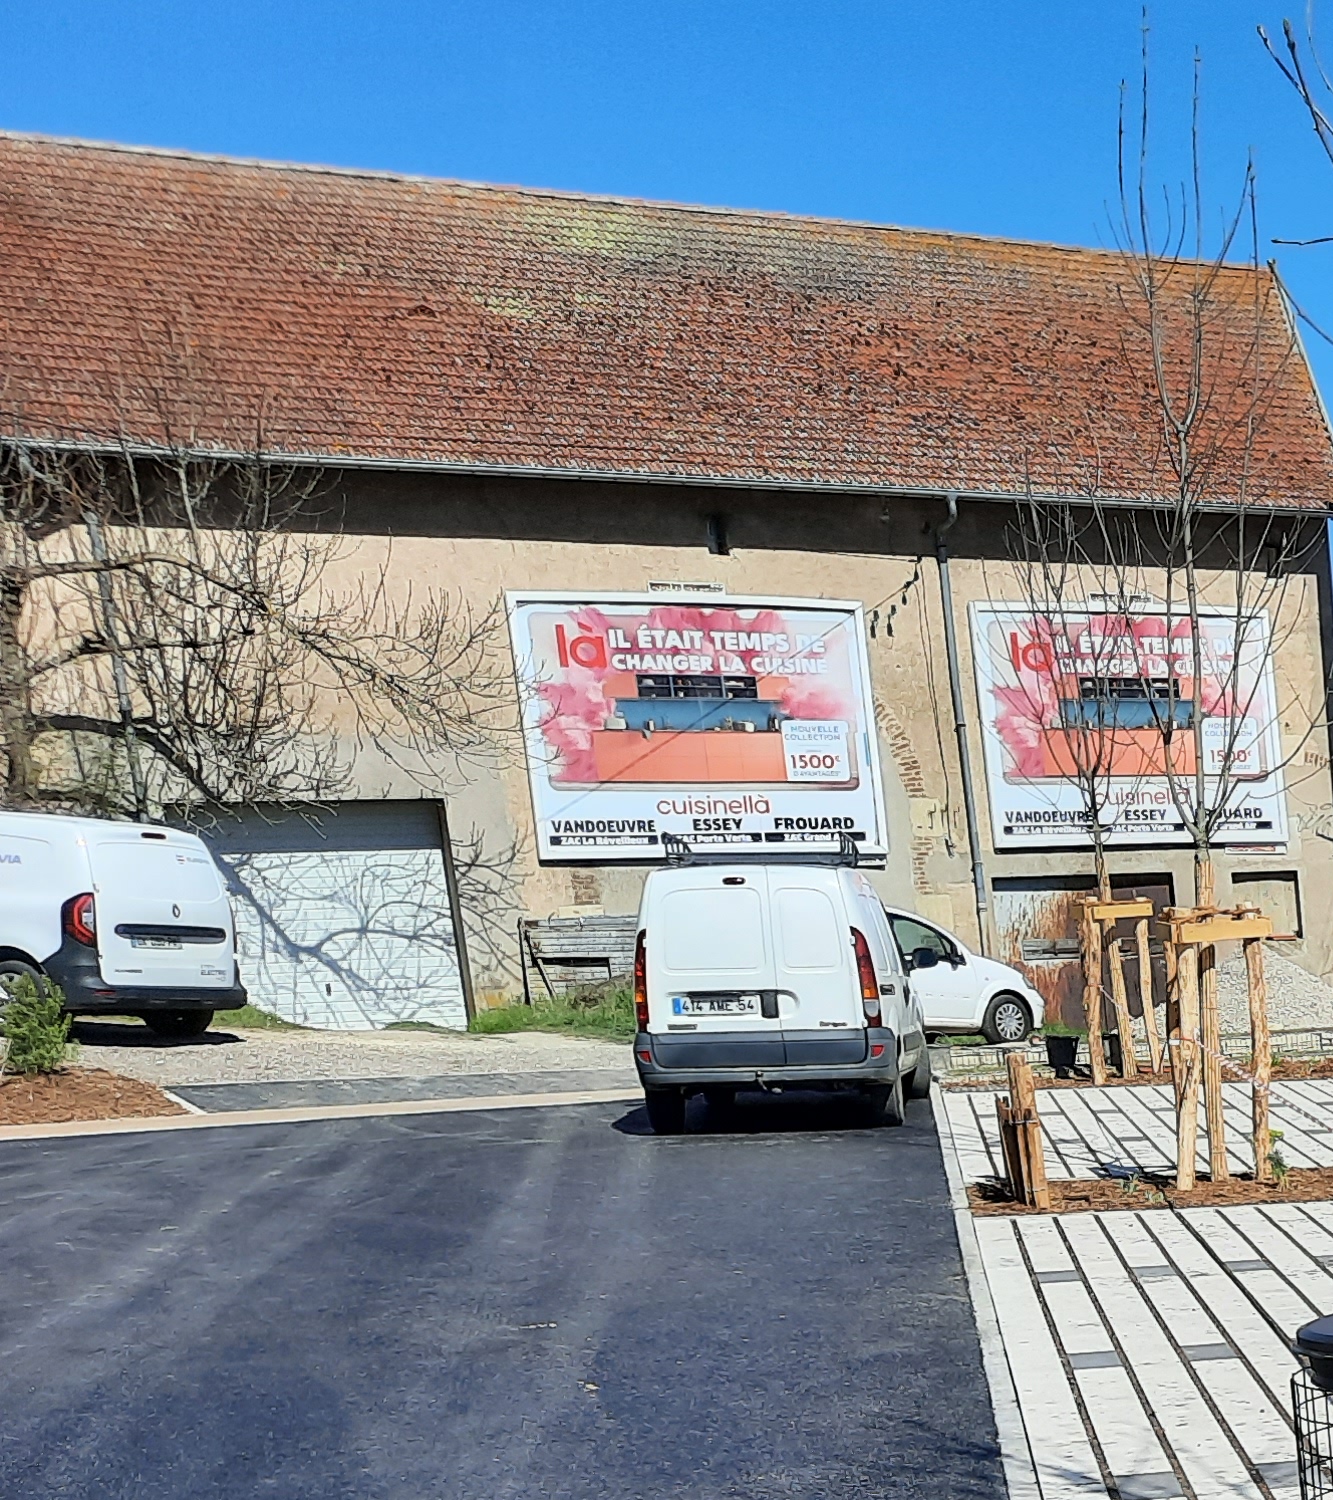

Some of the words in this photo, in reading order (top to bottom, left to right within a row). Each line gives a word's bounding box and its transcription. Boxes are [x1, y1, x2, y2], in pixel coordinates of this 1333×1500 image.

[555, 623, 608, 669] là
[608, 628, 632, 649] IL
[637, 624, 704, 650] ÉTAIT
[710, 631, 790, 652] TEMPS
[796, 634, 825, 653] DE
[611, 654, 714, 672] CHANGER
[719, 656, 747, 672] LA
[751, 657, 829, 674] CUISINE
[656, 794, 771, 815] cuisinellà
[1125, 809, 1166, 820] ESSEY
[551, 820, 656, 832] VANDOEUVRE
[692, 818, 742, 831] ESSEY
[774, 817, 854, 829] FROUARD
